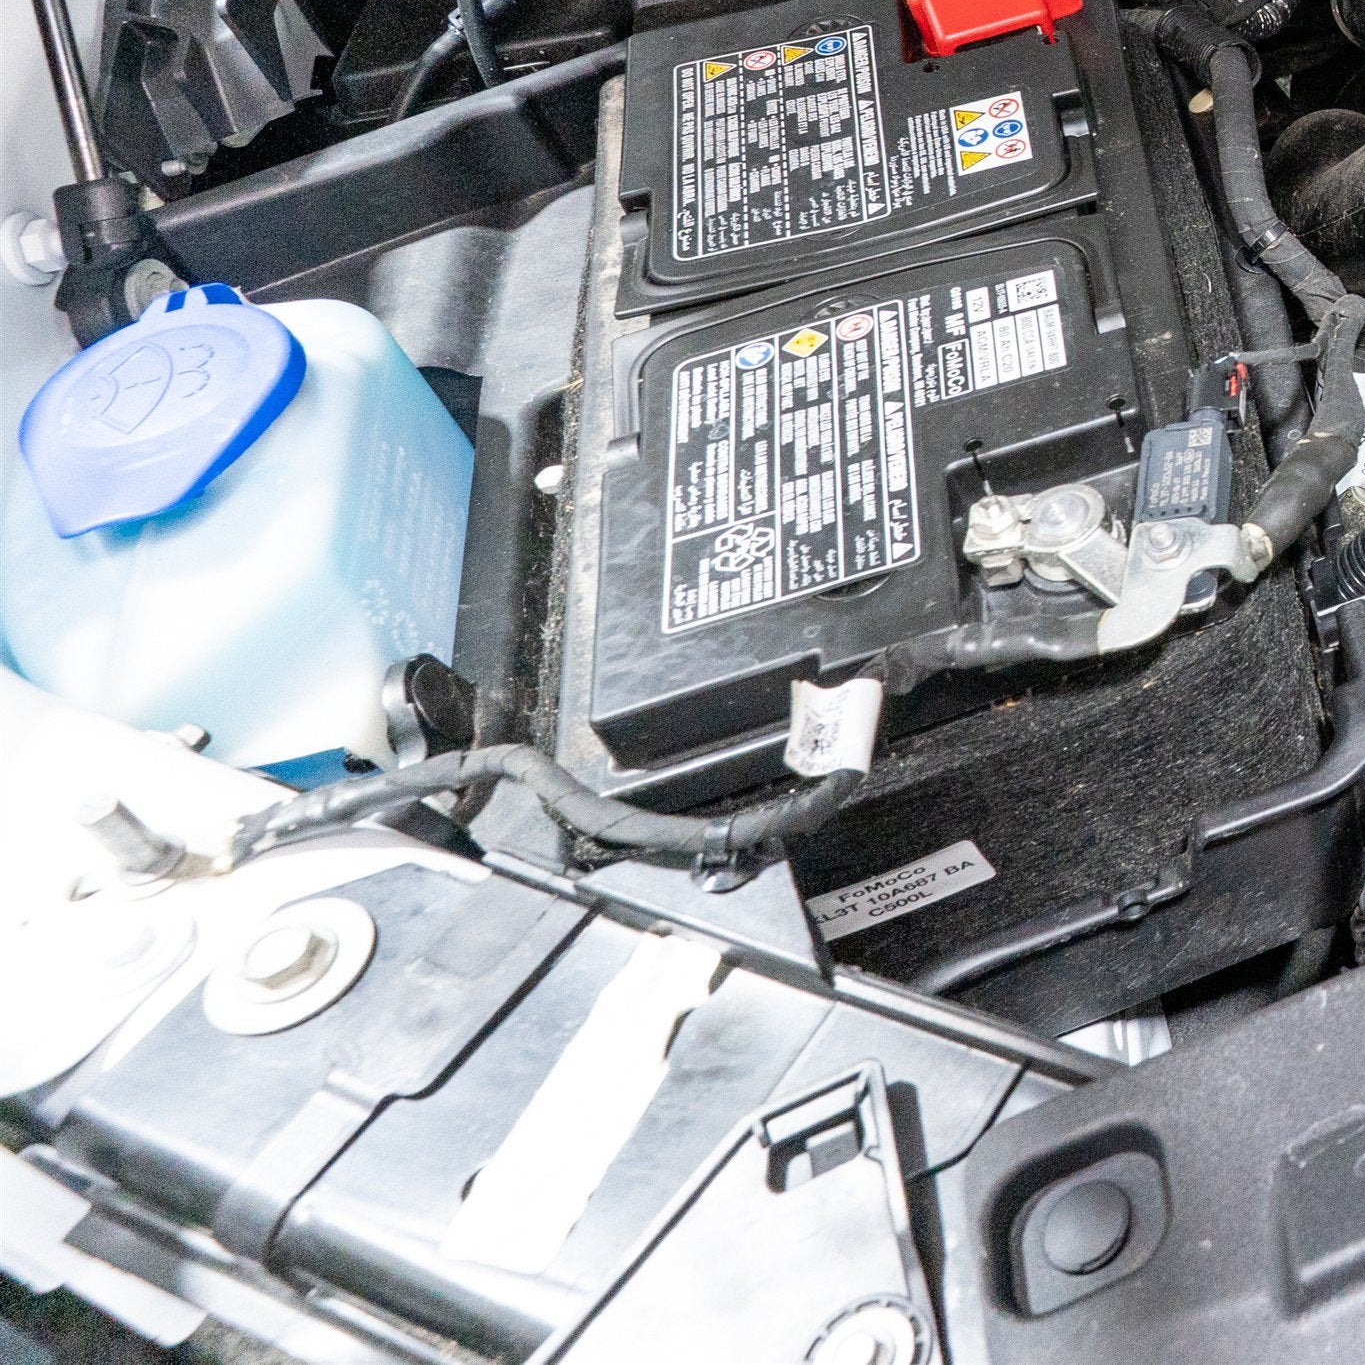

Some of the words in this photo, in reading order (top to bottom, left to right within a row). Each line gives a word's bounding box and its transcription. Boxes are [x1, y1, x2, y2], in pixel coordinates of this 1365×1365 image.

[852, 39, 872, 94] DANGER/POISON
[858, 107, 879, 167] PELIGRO/VENENO
[944, 312, 965, 338] MF
[972, 296, 983, 314] 12V
[998, 325, 1009, 337] 80
[999, 338, 1011, 352] Ah
[879, 319, 901, 394] DANGER/POISON
[944, 342, 966, 395] FoMoCo
[1001, 353, 1013, 373] C20
[884, 411, 907, 493] PELIGRO/VENENO
[838, 865, 927, 905] FoMoCo
